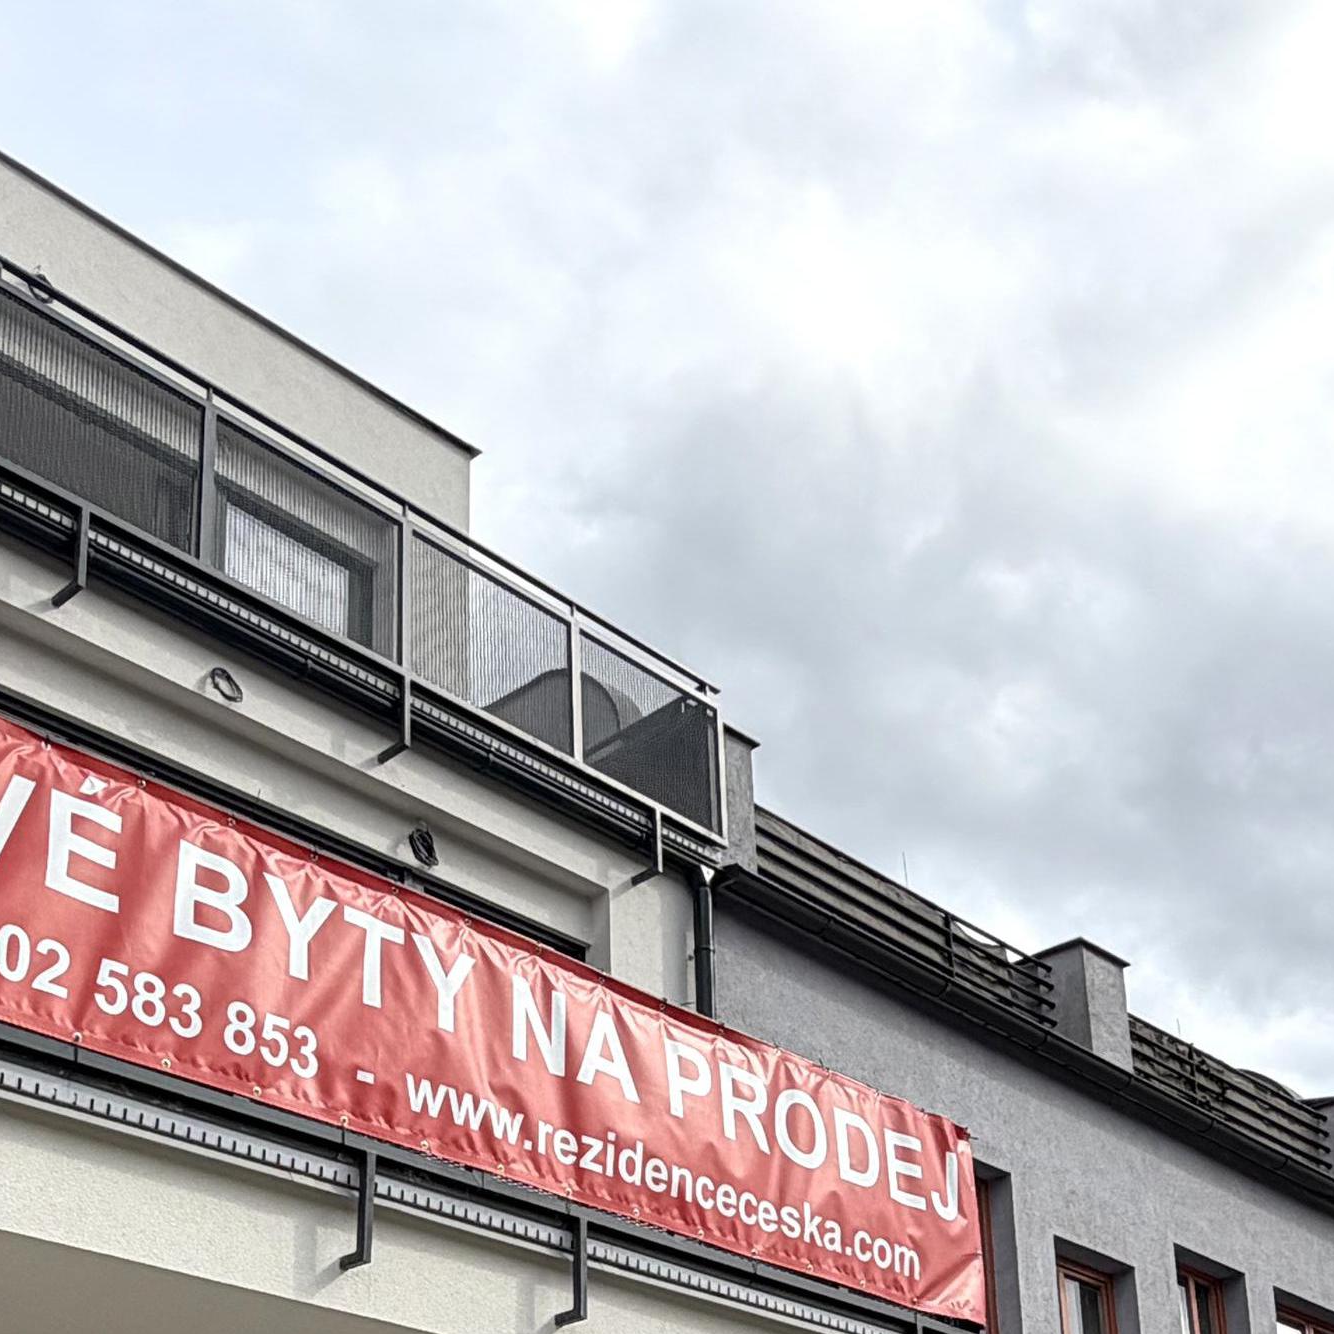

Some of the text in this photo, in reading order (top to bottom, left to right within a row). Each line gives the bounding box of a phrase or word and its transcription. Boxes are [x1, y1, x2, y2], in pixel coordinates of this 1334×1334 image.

[93, 956, 205, 1040] 583
[222, 999, 320, 1082] 853
[404, 1071, 922, 1281] www.rezidenceceska.com
[171, 838, 477, 1034] BYTY
[512, 976, 641, 1105] NA
[668, 1039, 960, 1222] PRODEJ
